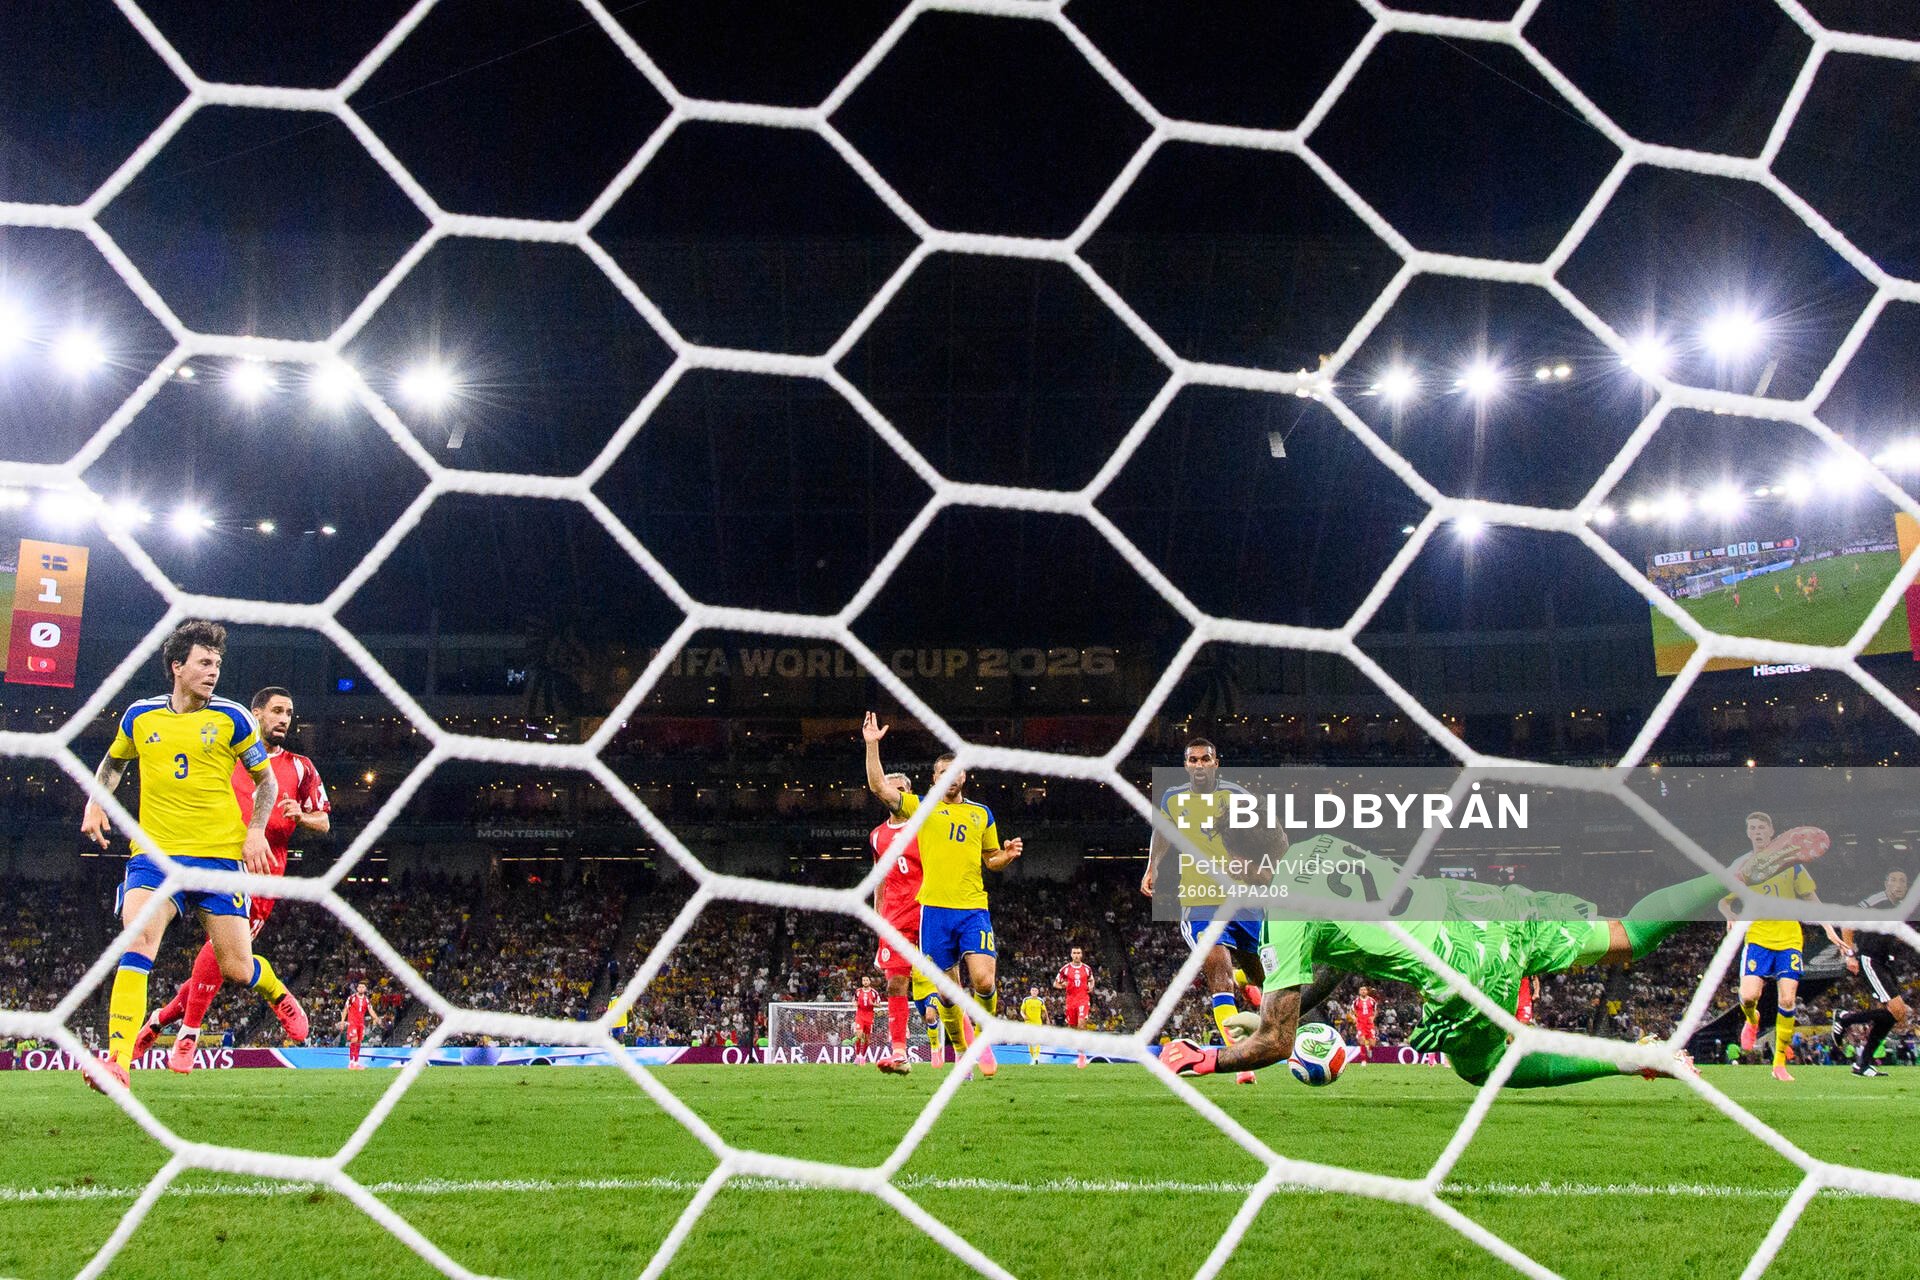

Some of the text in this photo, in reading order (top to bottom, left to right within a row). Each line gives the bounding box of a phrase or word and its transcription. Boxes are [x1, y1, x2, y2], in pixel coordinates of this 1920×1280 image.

[38, 577, 62, 604] 1
[30, 622, 61, 648] 0
[655, 646, 1116, 677] IFA WORL CUP 2026
[1753, 663, 1811, 677] Hisense
[174, 753, 189, 779] 3
[477, 829, 575, 838] MONTERREY
[948, 822, 968, 843] 16
[897, 856, 909, 874] 8
[1763, 883, 1779, 897] 21
[980, 930, 994, 951] 16
[815, 1046, 923, 1064] AIRWAS
